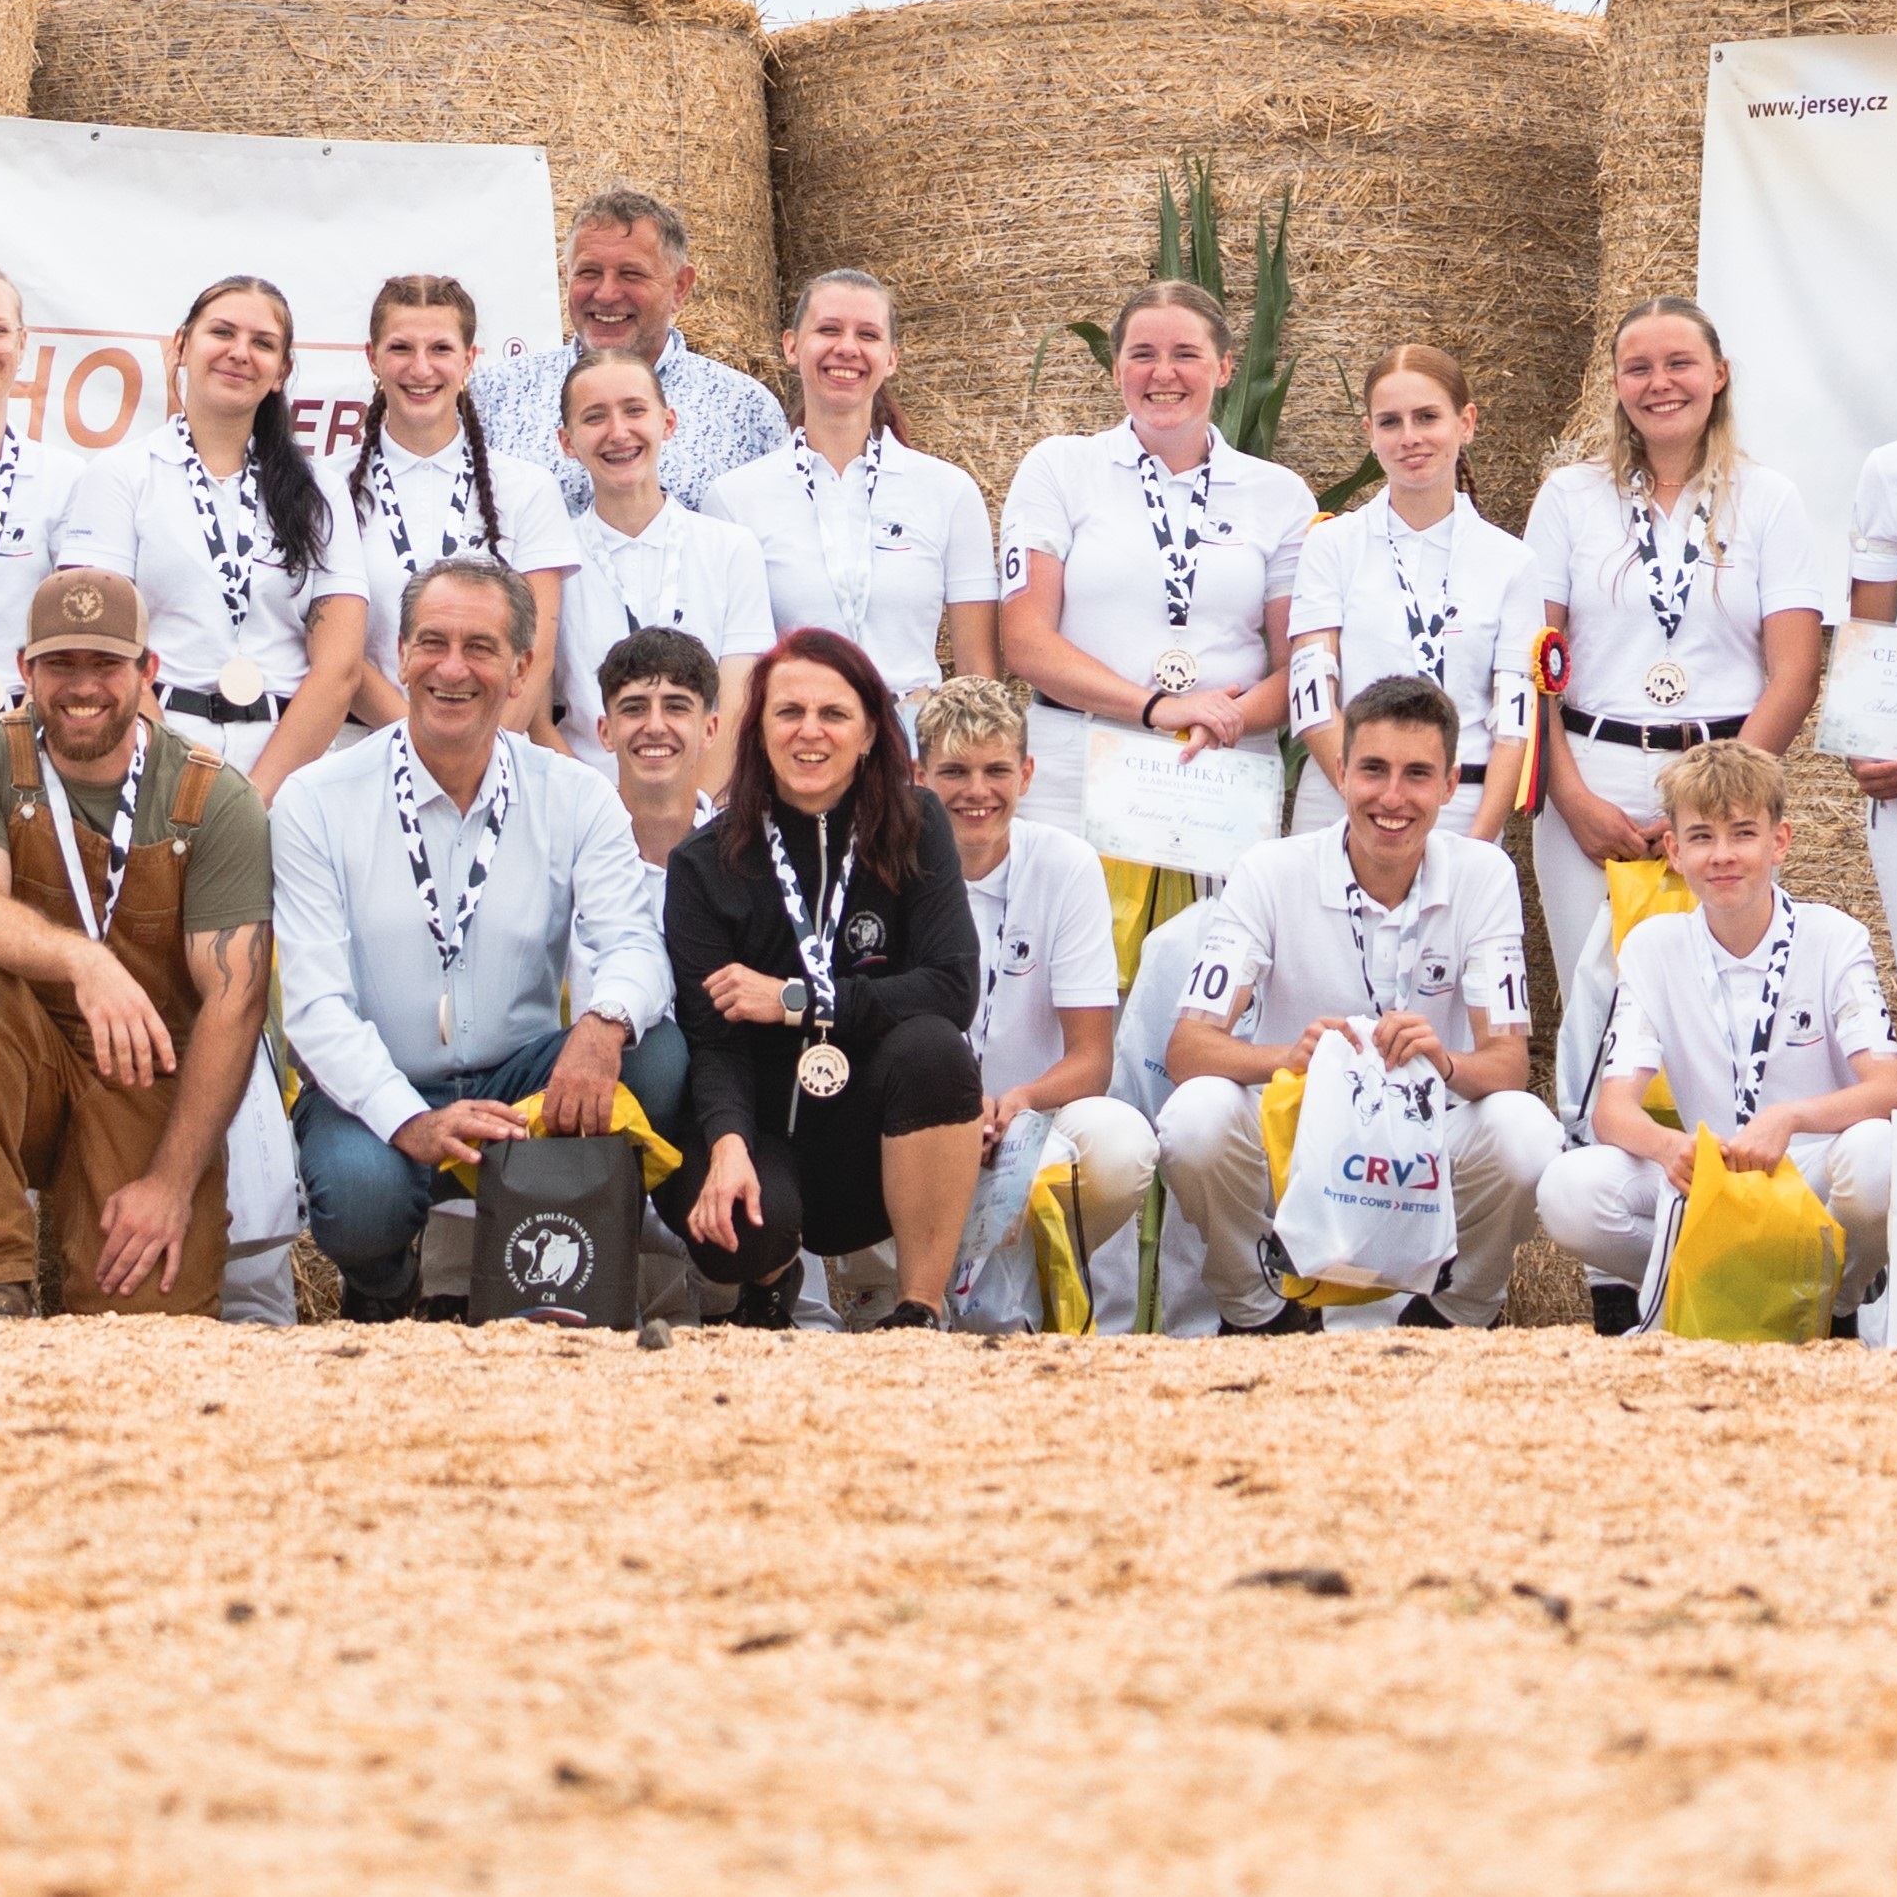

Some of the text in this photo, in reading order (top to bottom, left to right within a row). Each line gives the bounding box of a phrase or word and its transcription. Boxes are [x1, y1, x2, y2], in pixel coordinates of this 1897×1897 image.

[1748, 95, 1888, 119] www.jersey.cz
[1006, 547, 1020, 580] 6
[1292, 678, 1319, 720] 11
[1189, 961, 1229, 1000] 10
[1343, 1154, 1415, 1187] CRV
[1360, 1196, 1392, 1209] COWS
